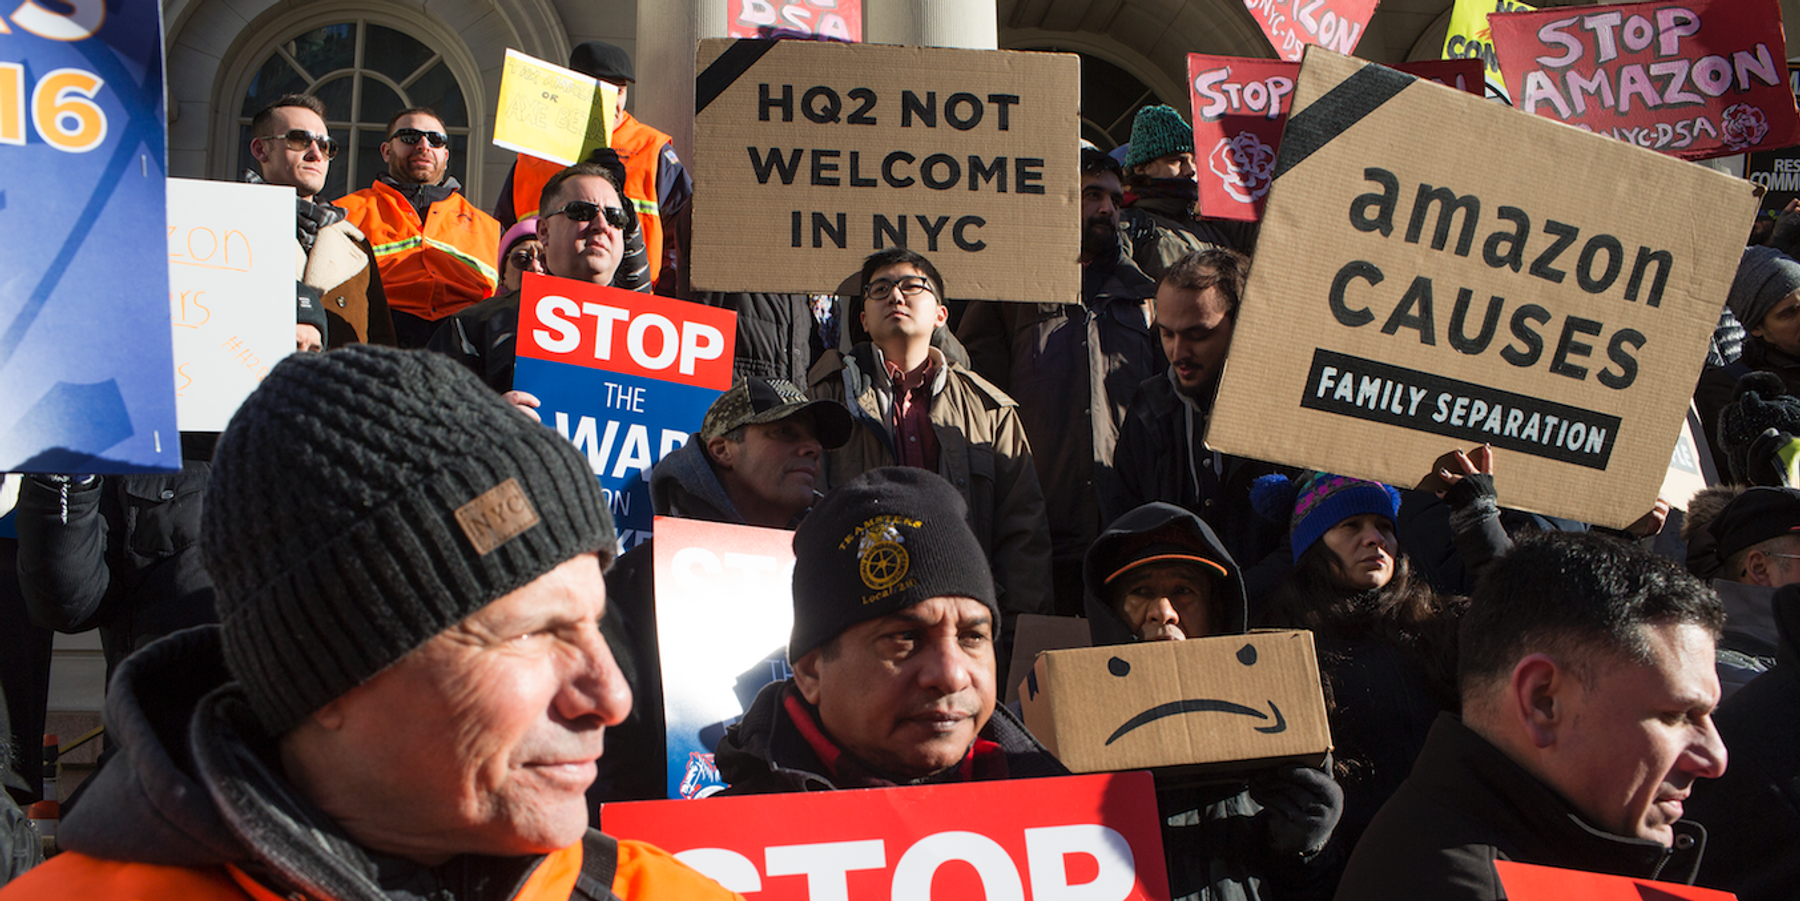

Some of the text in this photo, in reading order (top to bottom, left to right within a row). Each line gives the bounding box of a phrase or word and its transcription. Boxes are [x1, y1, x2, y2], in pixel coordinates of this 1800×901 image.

[1535, 7, 1701, 68] STOP
[541, 91, 559, 104] OR
[758, 83, 1020, 132] HQ2 NOT
[1194, 66, 1295, 122] STOP
[1523, 43, 1781, 121] AMAZON
[505, 91, 549, 130] AXE
[747, 146, 1046, 195] WELCOME
[791, 211, 987, 252] IN NYC
[1349, 167, 1674, 308] amazon
[532, 295, 725, 376] STOP
[1328, 260, 1648, 390] CAUSES
[604, 382, 646, 413] THE
[1316, 366, 1607, 454] FAMILY SEPARATION
[466, 495, 524, 537] NYC
[671, 547, 797, 610] ST
